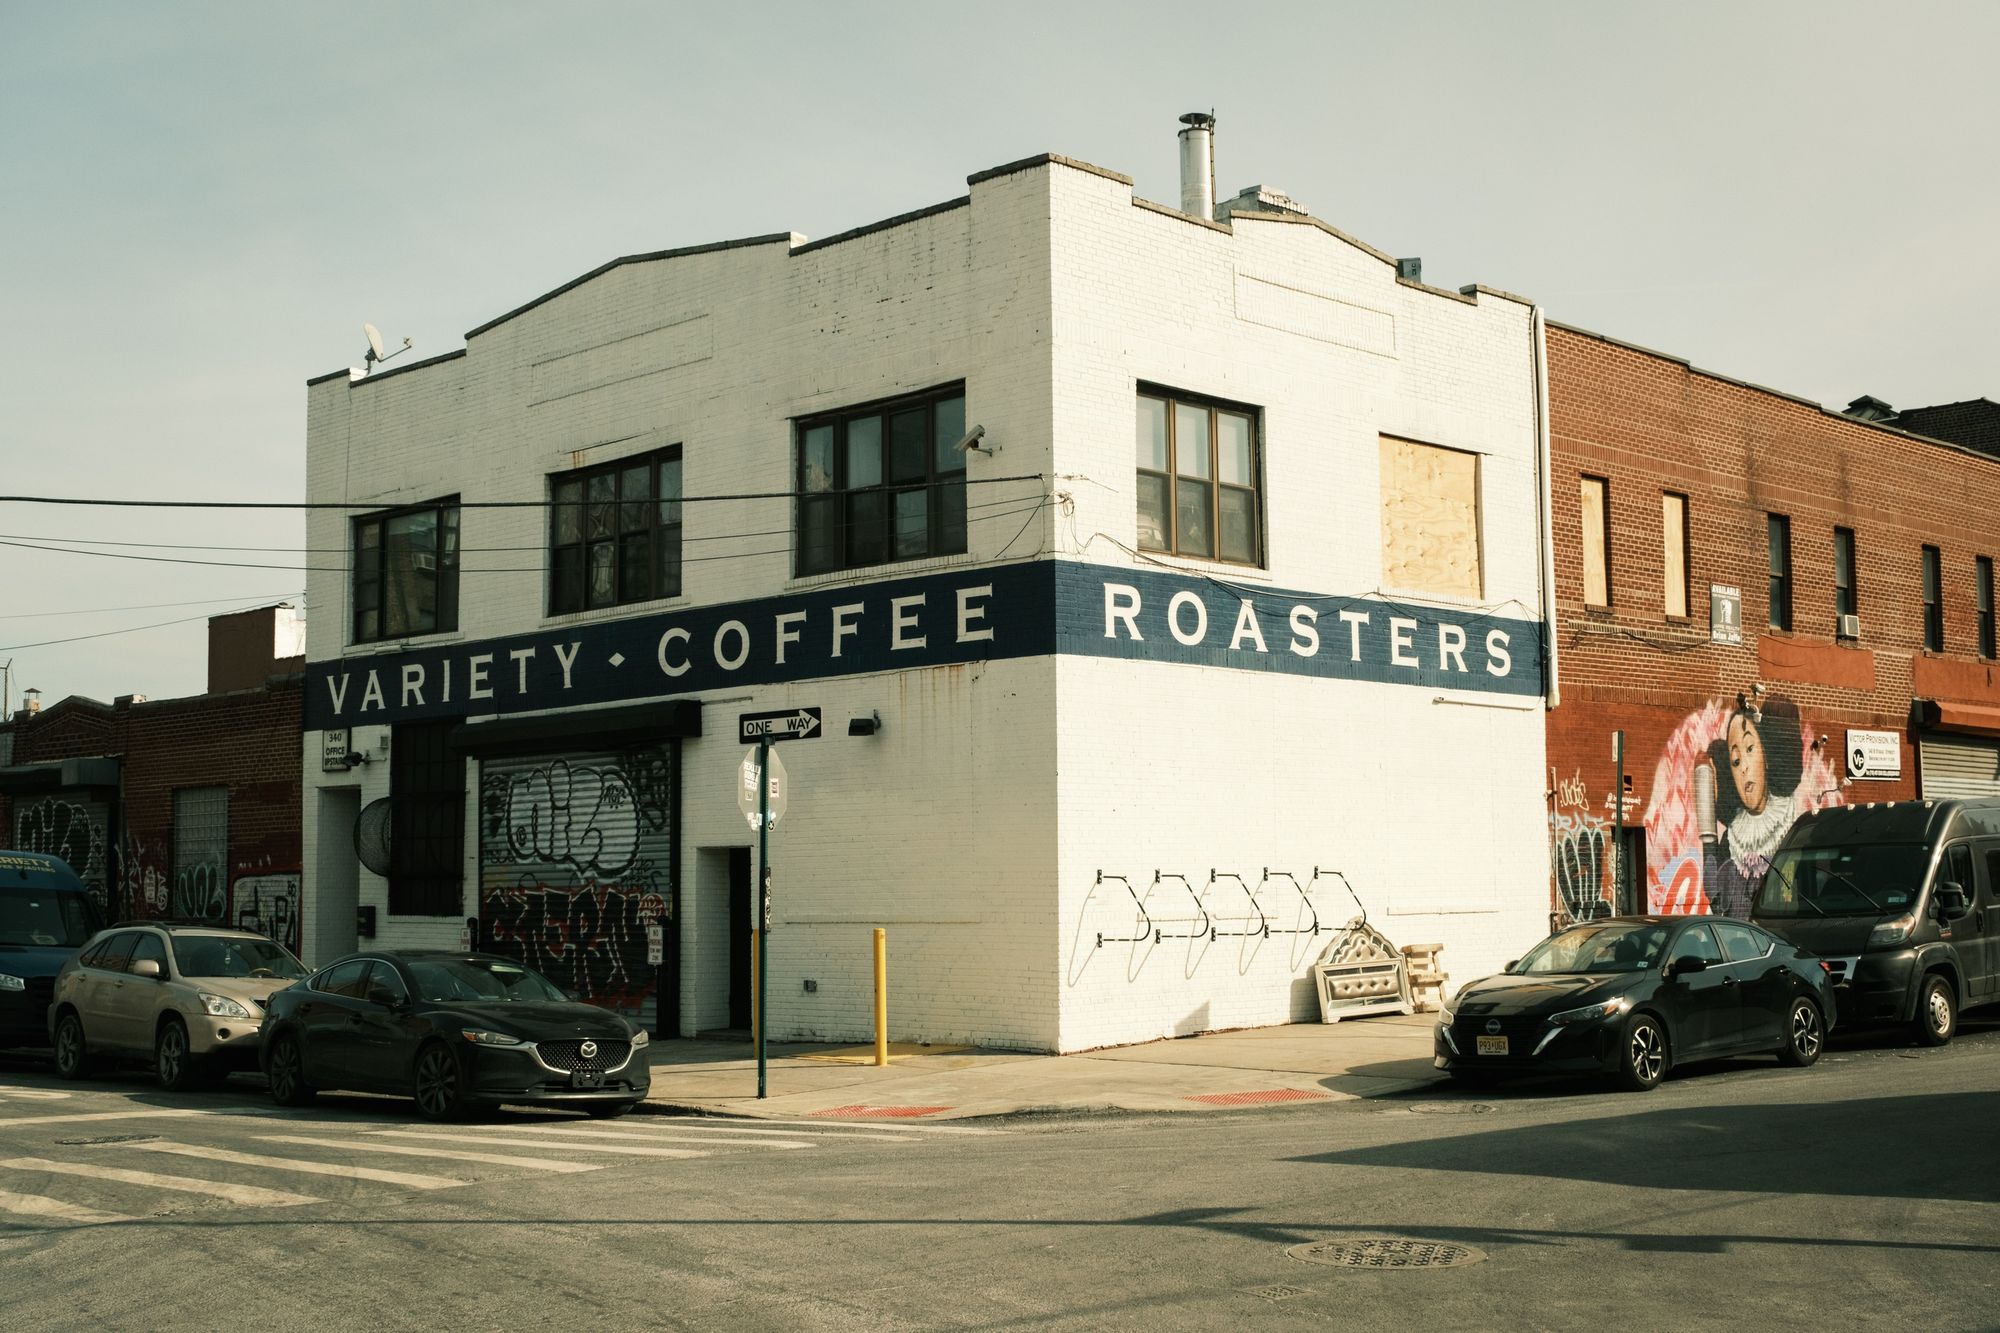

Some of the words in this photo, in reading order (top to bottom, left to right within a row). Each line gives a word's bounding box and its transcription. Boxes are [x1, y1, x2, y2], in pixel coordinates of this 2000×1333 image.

[1712, 584, 1739, 596] AVAILABLE
[1103, 583, 1511, 677] ROASTERS
[326, 641, 582, 715] VARIETY
[658, 583, 994, 677] COFFEE
[746, 720, 772, 734] ONE
[786, 717, 812, 731] WAY
[329, 733, 342, 742] 340
[326, 746, 345, 755] OFFICE
